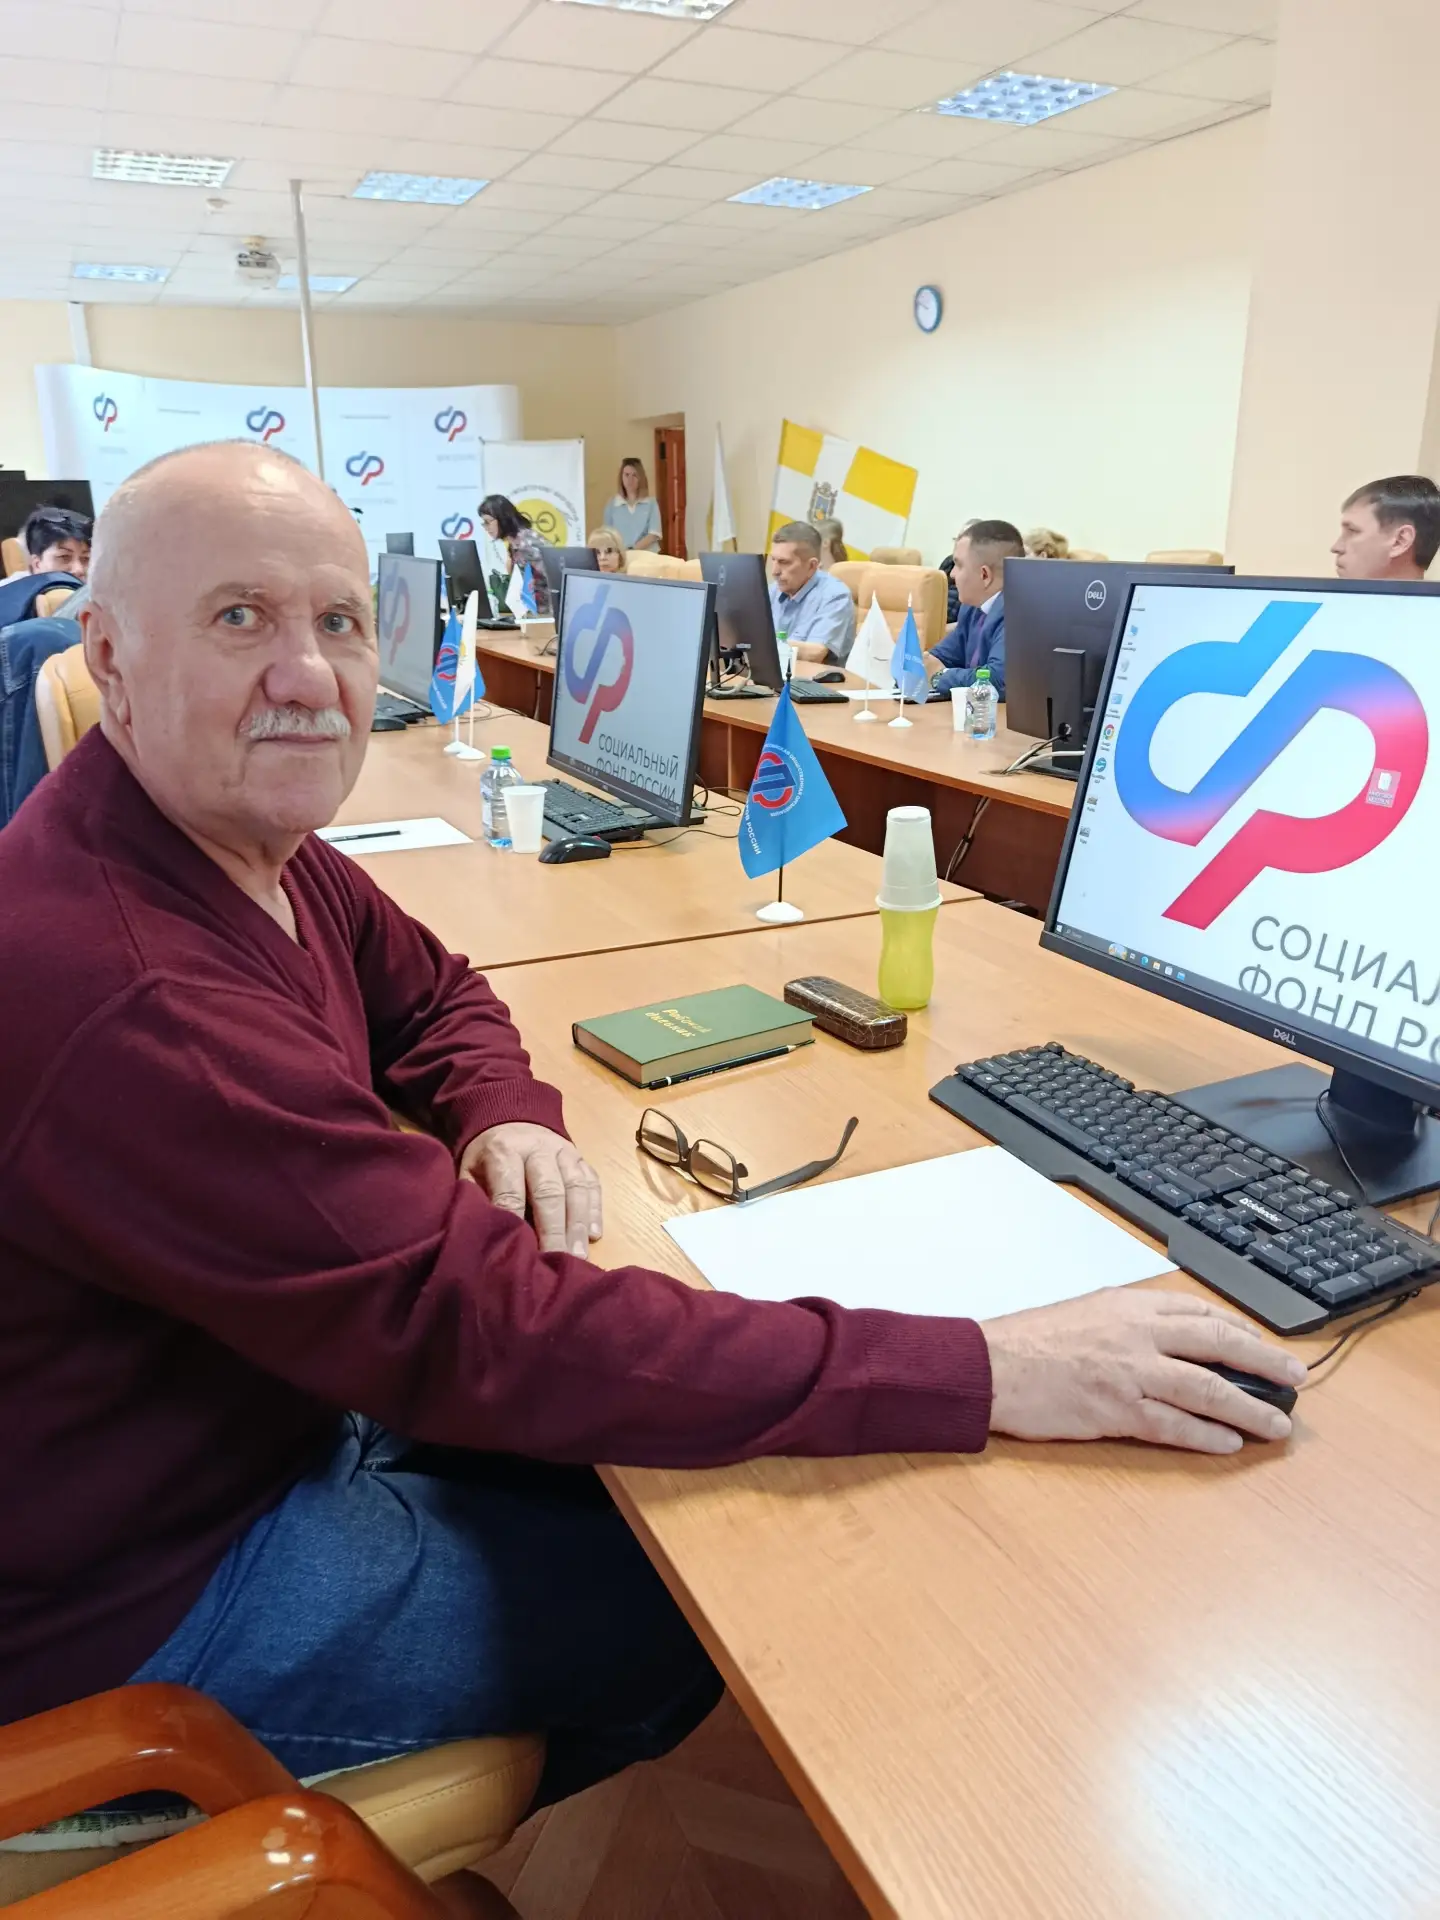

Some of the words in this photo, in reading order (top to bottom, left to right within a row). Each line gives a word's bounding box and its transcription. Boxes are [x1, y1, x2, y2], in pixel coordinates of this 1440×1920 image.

[1088, 591, 1104, 600] DELL
[598, 733, 679, 781] СОЦИАЛЬНЫЙ
[746, 821, 763, 856] РОССИИ
[1272, 1028, 1297, 1046] DELL
